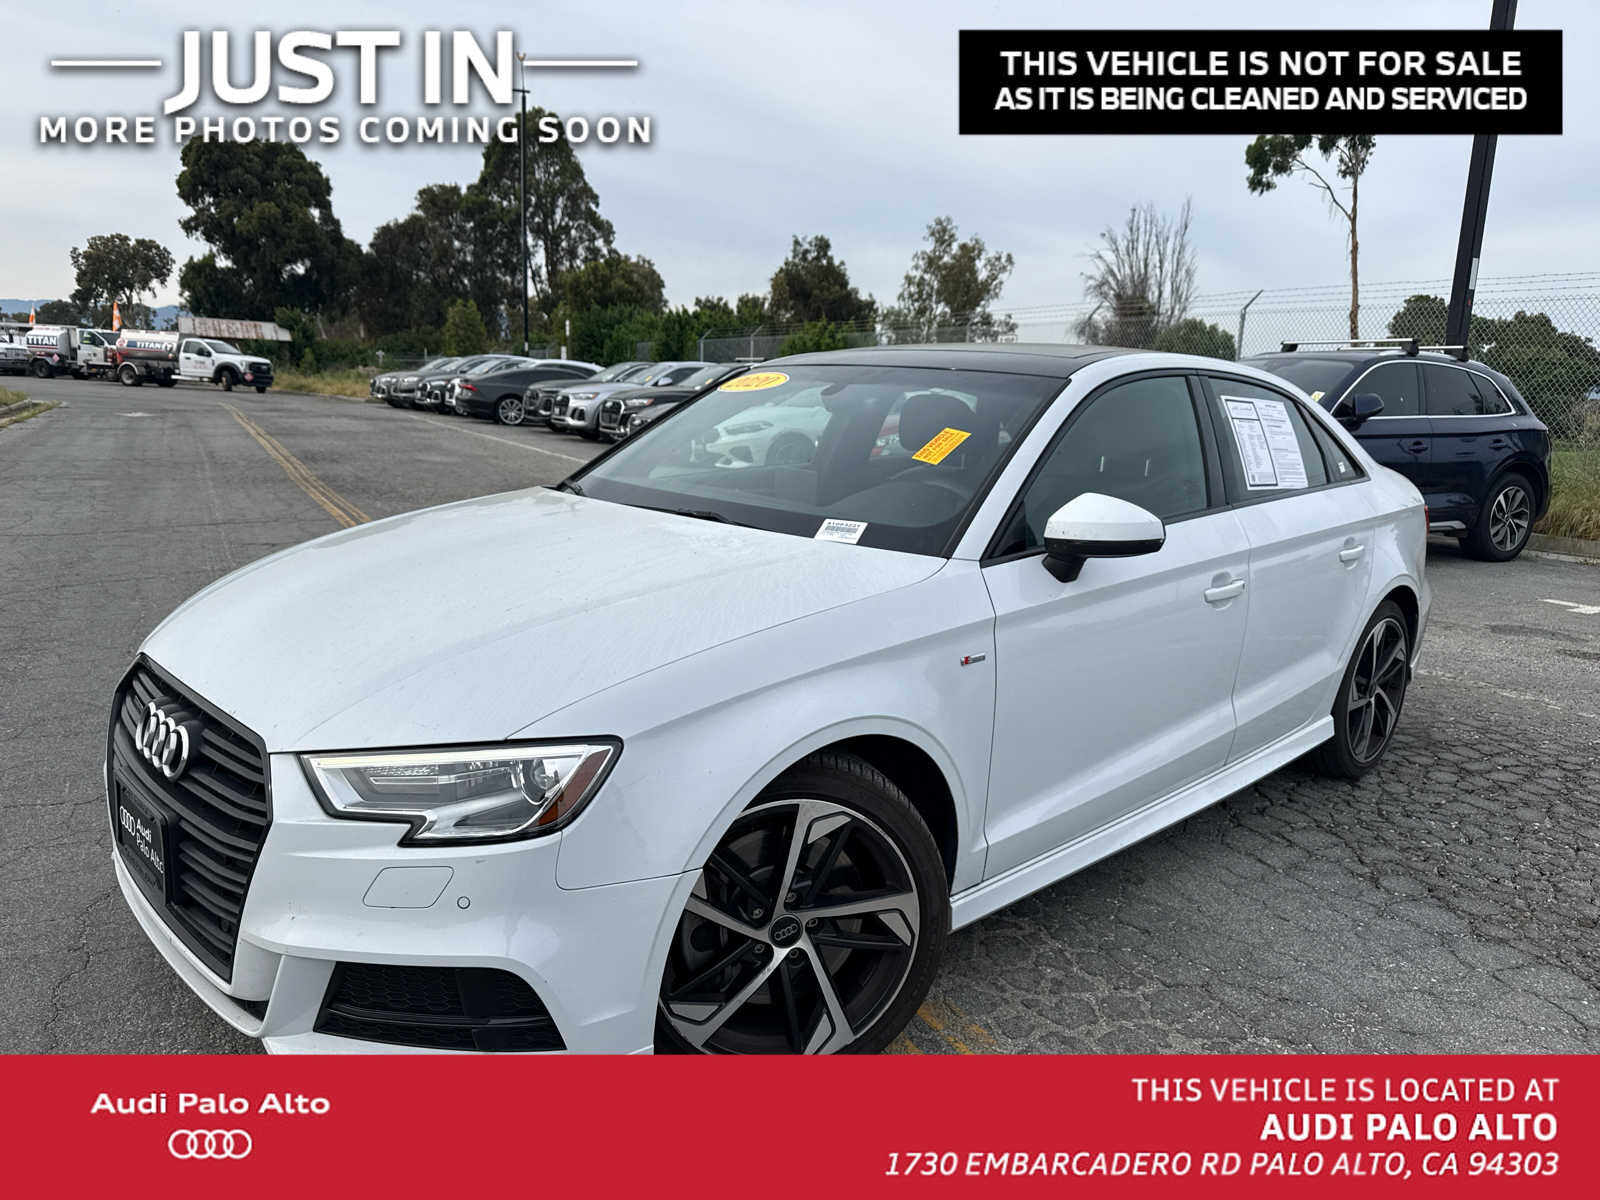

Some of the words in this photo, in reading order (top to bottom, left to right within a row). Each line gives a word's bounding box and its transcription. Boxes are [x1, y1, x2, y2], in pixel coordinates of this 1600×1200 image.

[27, 335, 57, 345] TITAN
[136, 341, 162, 350] TITAN
[136, 818, 152, 844] Audi
[136, 832, 150, 859] Palo
[150, 848, 165, 875] Alto
